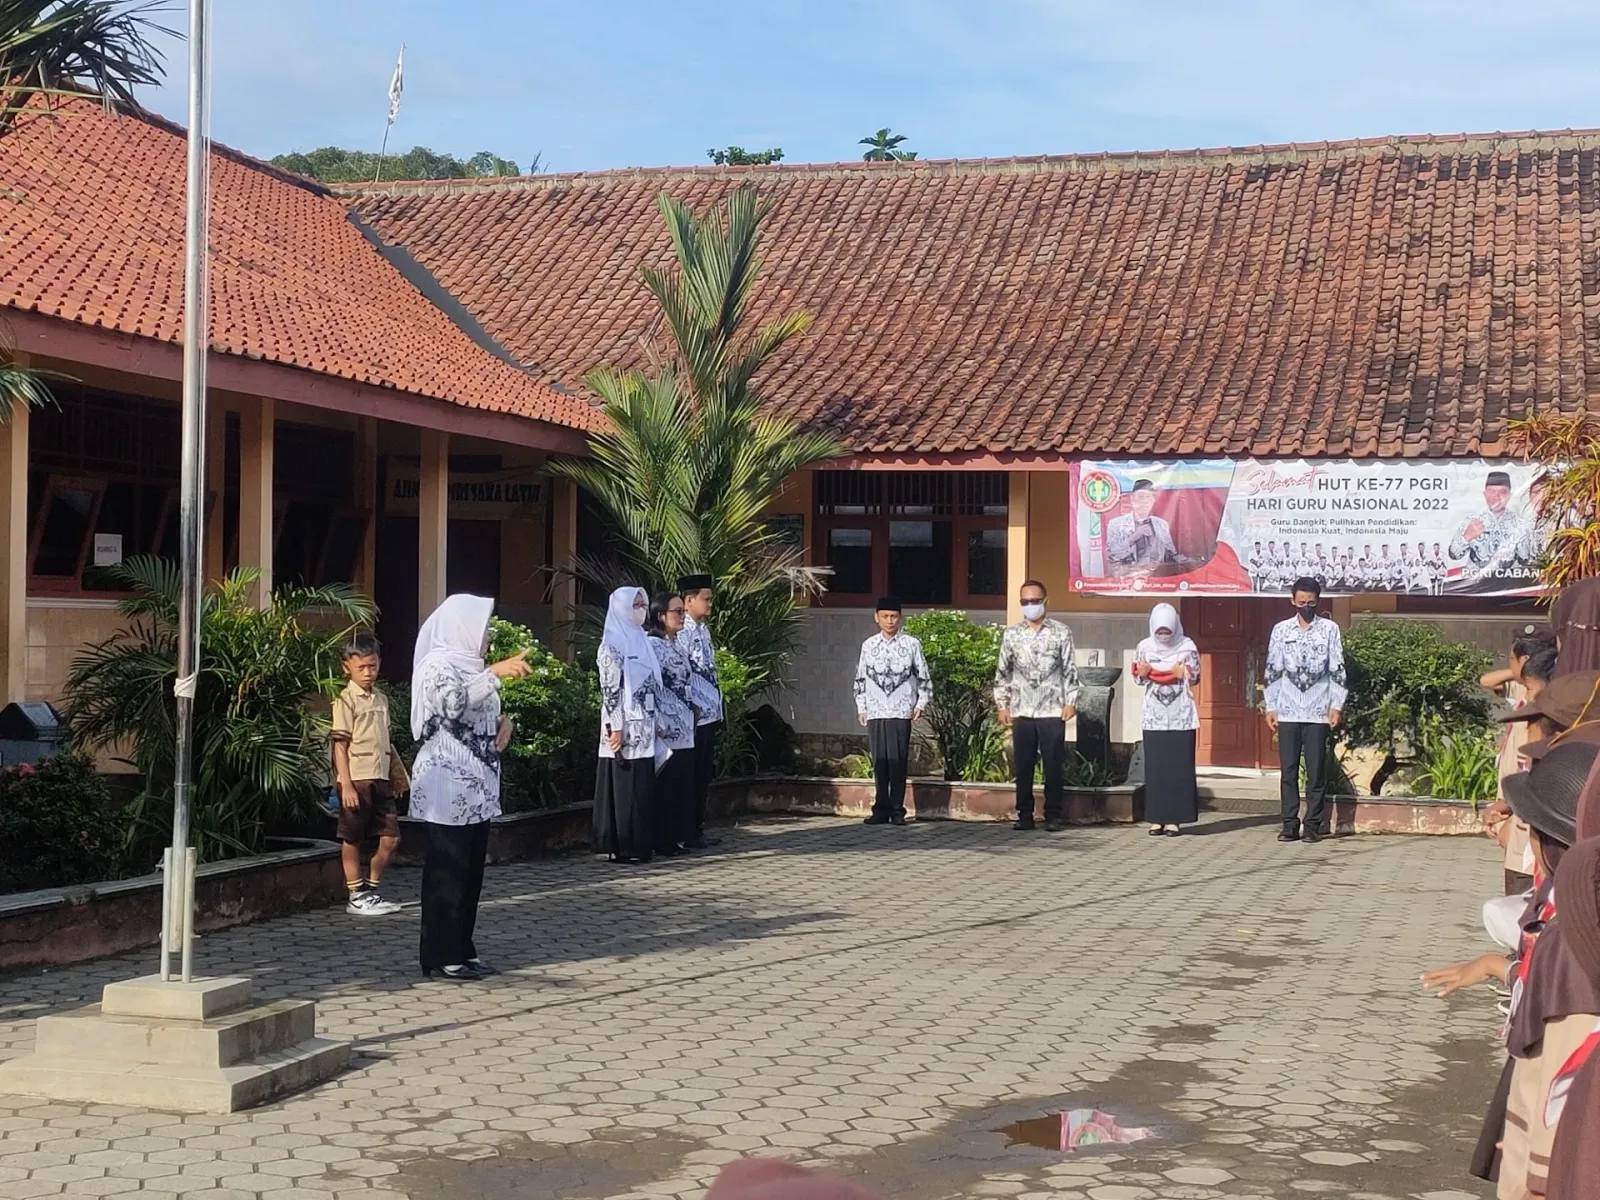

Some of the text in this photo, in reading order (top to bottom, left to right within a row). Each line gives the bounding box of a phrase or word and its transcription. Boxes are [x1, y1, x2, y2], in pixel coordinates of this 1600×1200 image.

[1248, 465, 1329, 496] Selamat
[1318, 478, 1449, 491] HUT KE-77 PGRI
[1247, 498, 1449, 511] HARI GURU NASIONAL 2022
[1270, 518, 1418, 528] Guru Bangkit, Pulihkan Pendidikan:
[1279, 527, 1409, 536] Indonesia Kuat, Indonesia Maju
[1462, 568, 1492, 578] PGRI
